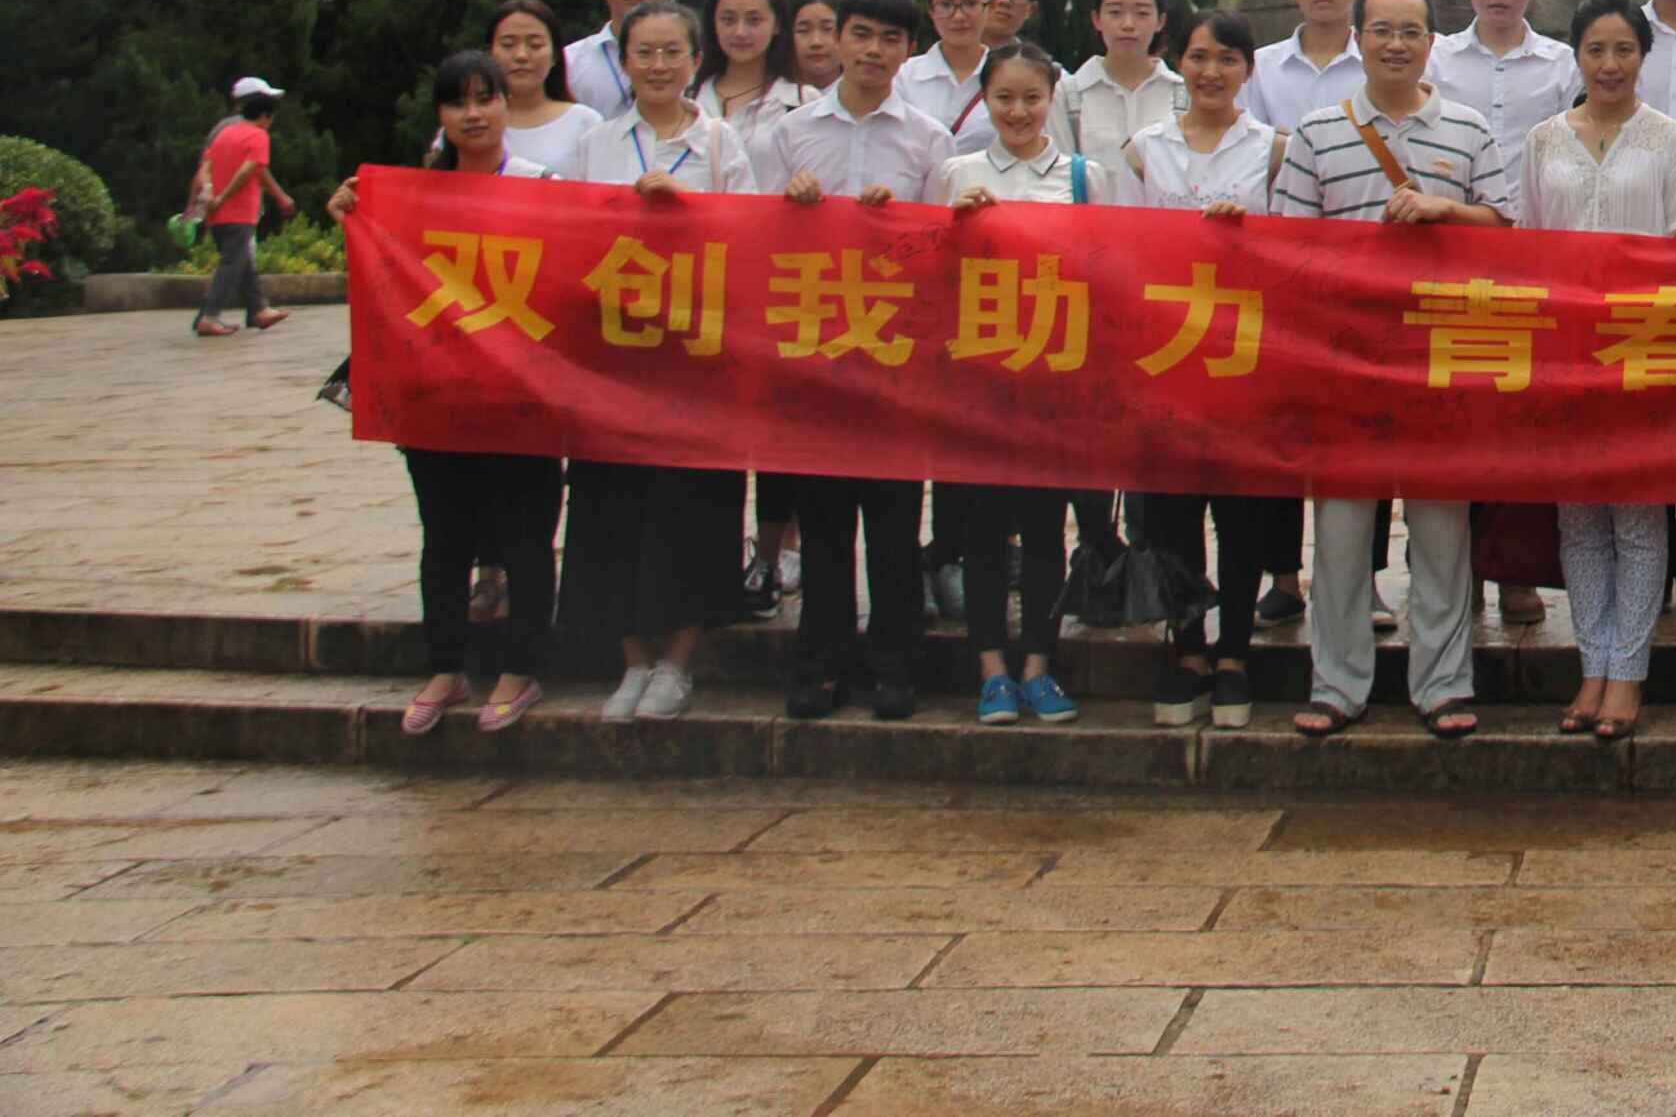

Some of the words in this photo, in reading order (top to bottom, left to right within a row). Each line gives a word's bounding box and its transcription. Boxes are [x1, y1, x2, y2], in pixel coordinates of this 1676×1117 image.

[407, 231, 1264, 378] 双创我助力
